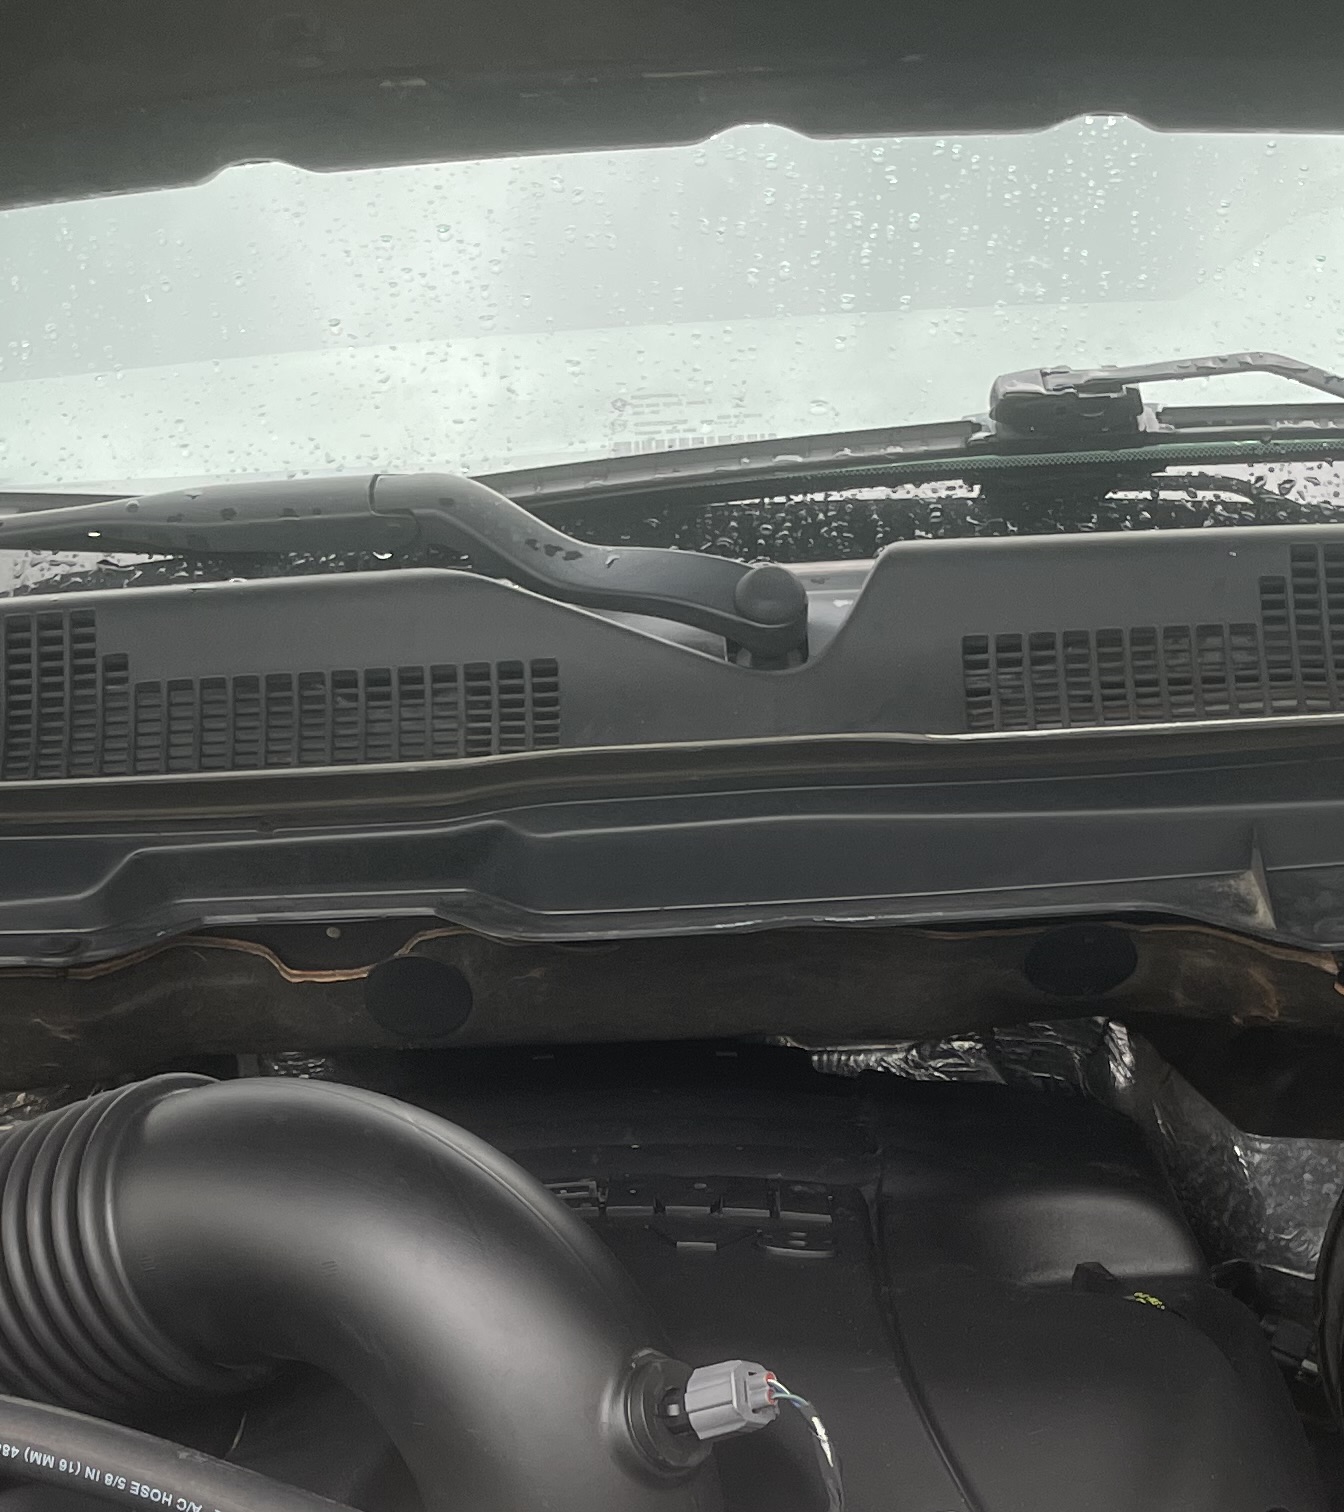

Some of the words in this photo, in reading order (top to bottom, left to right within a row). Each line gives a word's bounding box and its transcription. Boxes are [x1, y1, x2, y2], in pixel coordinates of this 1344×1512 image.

[24, 1448, 55, 1468] MM)
[59, 1458, 81, 1476] (16
[85, 1465, 101, 1480] IN
[106, 1473, 126, 1490] 5/8
[130, 1480, 172, 1507] HOSE
